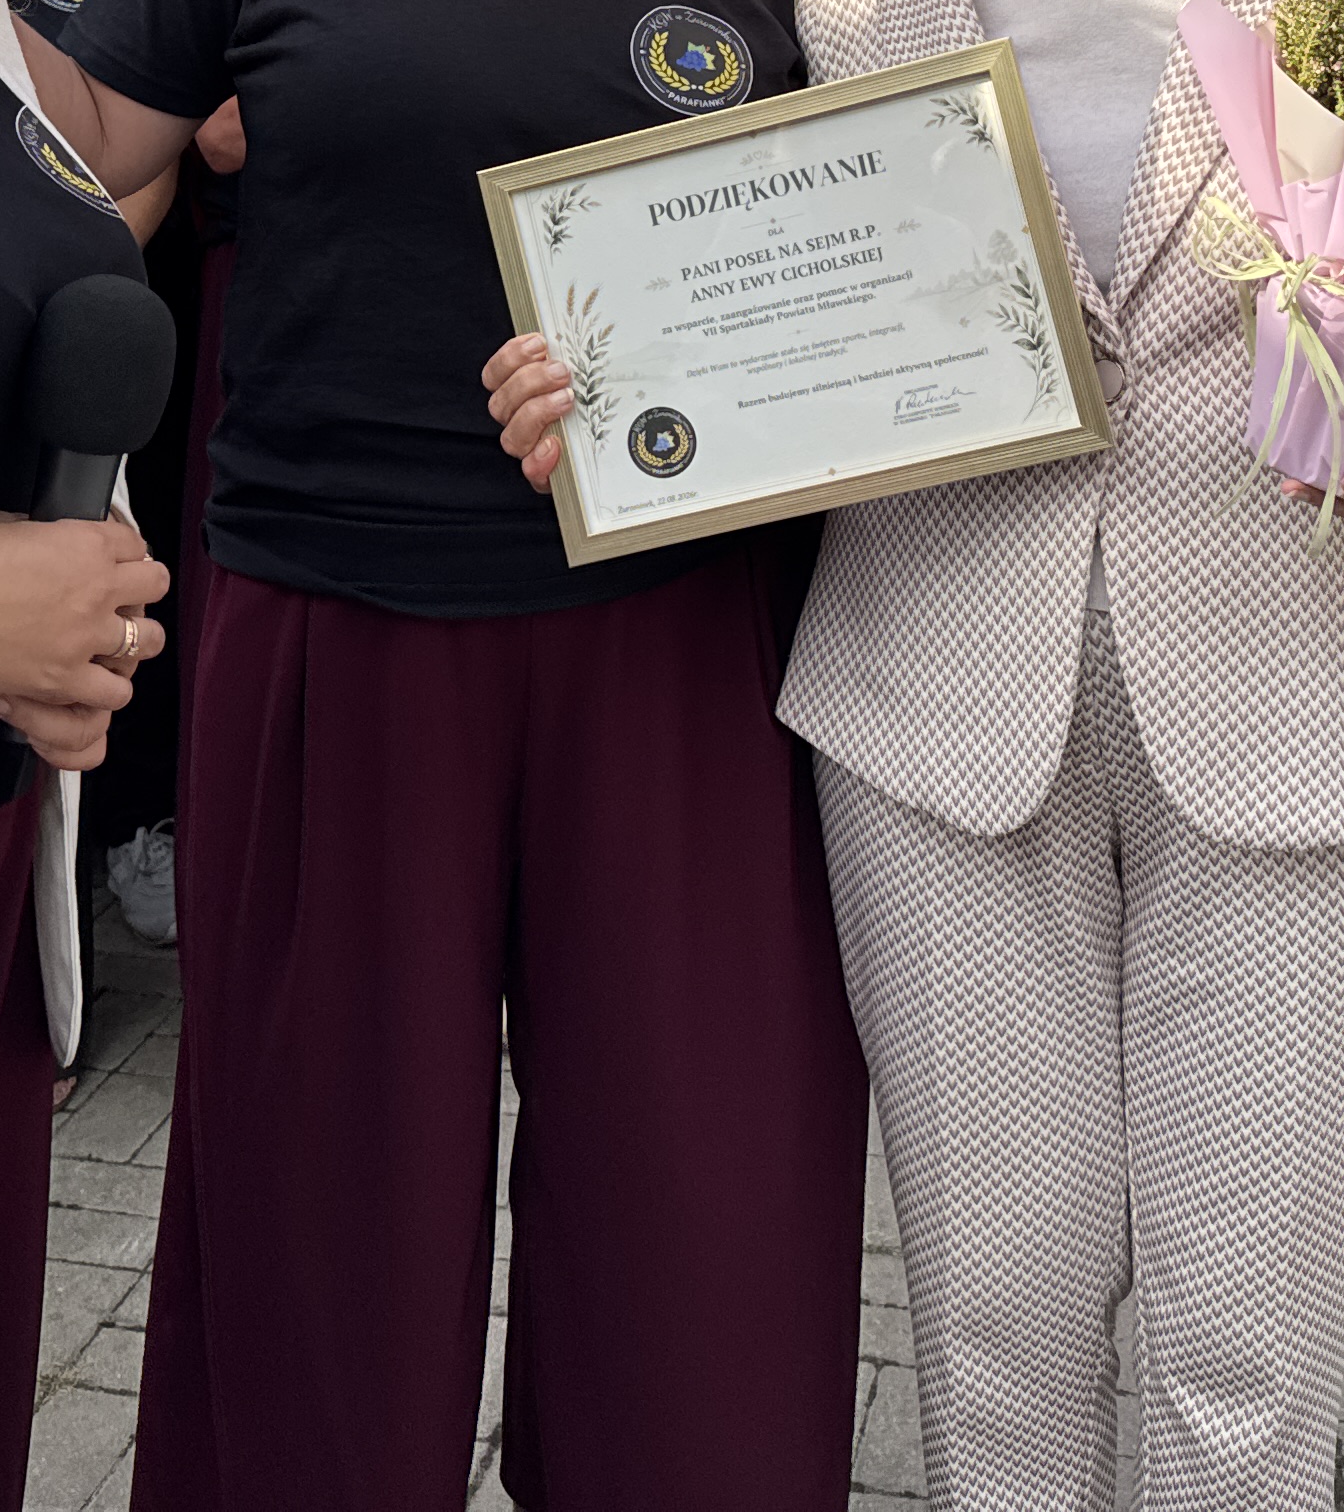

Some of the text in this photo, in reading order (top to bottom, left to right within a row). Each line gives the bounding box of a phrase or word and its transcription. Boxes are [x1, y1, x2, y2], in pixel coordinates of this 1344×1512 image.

[648, 150, 887, 227] PODZIĘKOWANIE
[681, 224, 882, 282] PANI POSEŁ NA SEJM R.P.
[768, 227, 785, 236] DLA
[662, 326, 673, 335] za
[675, 315, 719, 333] wsparcie,
[793, 294, 814, 305] oraz
[816, 287, 848, 302] pomoc
[860, 269, 914, 290] organizacji
[690, 247, 884, 303] ANNY EWY CICHOLSKIEJ
[702, 292, 877, 337] VII Spartakiady Powiatu Mławskiego.
[858, 366, 894, 383] bardziej
[895, 360, 932, 375] aktywną
